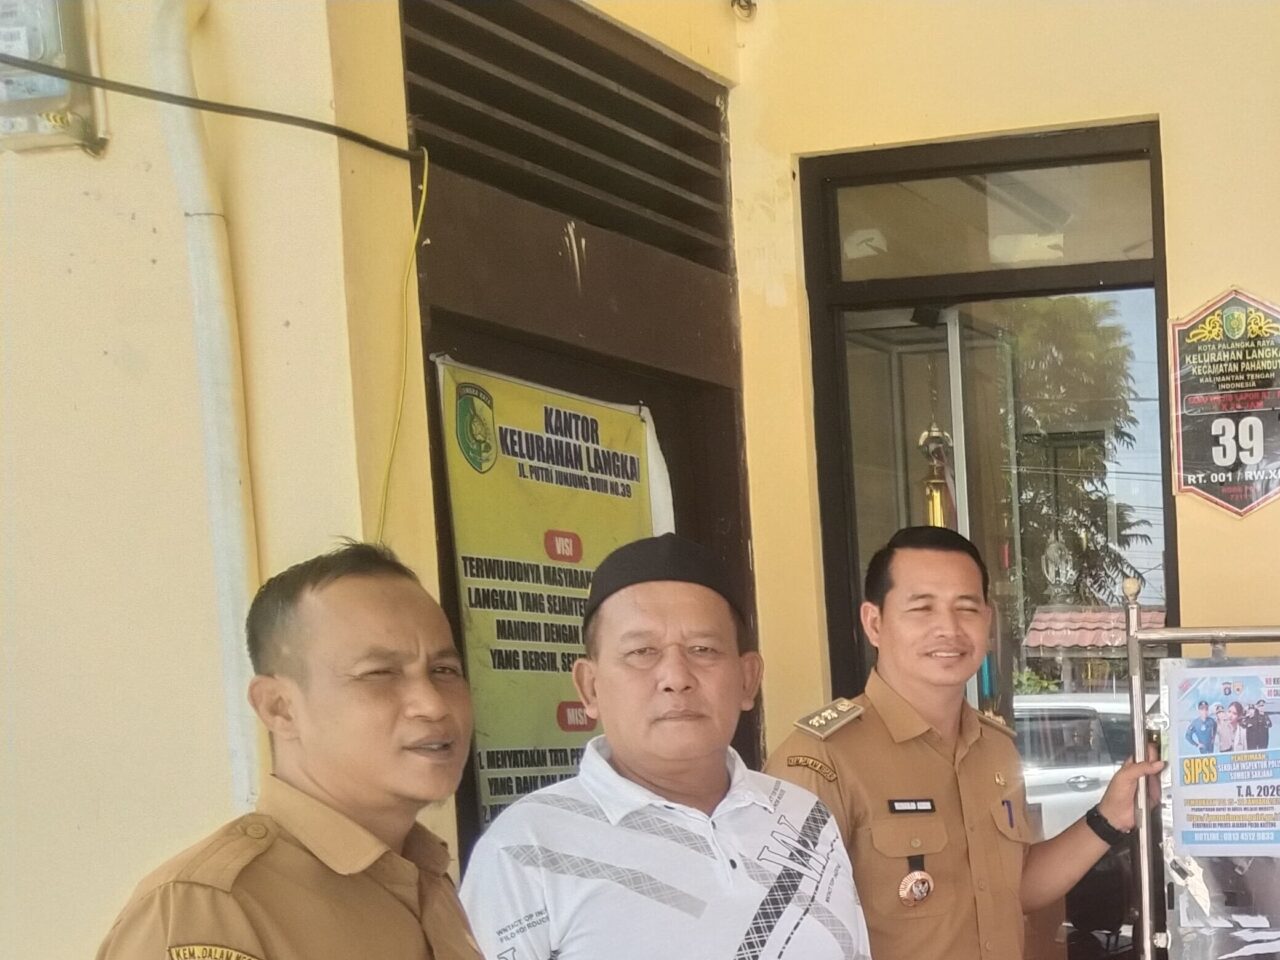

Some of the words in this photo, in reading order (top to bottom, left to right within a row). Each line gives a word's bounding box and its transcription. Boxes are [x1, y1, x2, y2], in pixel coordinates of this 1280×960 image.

[1197, 344, 1216, 352] KOTA
[1217, 341, 1255, 350] PALANGKA
[1256, 339, 1275, 348] RAYA
[1185, 350, 1243, 364] KELURAHAN
[1192, 363, 1239, 376] KECAMATAN
[1199, 375, 1246, 384] KALIMANTAN
[1246, 372, 1276, 380] TENGAH
[1218, 381, 1257, 390] INDONESIA
[543, 405, 600, 445] KANTOR
[1210, 416, 1264, 467] 39
[498, 426, 584, 471] KELURAHAN
[585, 445, 641, 482] LANGKAI
[528, 465, 554, 484] PUTRI
[554, 468, 590, 490] JUNJUNG
[609, 479, 632, 498] NO.39
[1187, 474, 1207, 484] RT.
[1210, 472, 1233, 483] 001
[554, 536, 574, 556] VISI
[461, 555, 543, 585] TERWUJUDNYA
[542, 565, 592, 590] MASYARAK
[467, 587, 518, 611] LANGKAI
[518, 591, 546, 614] YANG
[546, 594, 588, 618] SEJAHTE
[495, 618, 542, 642] MANDIRI
[543, 622, 580, 645] DENGAN
[489, 648, 520, 670] YANG
[566, 707, 588, 726] MISI
[486, 749, 548, 769] MENYATAKAN
[548, 748, 570, 767] TATA
[1183, 756, 1218, 785] SIPSS
[487, 776, 514, 797] YANG
[1236, 785, 1244, 797] T.
[1245, 785, 1255, 797] A.
[201, 947, 233, 960] DALAM
